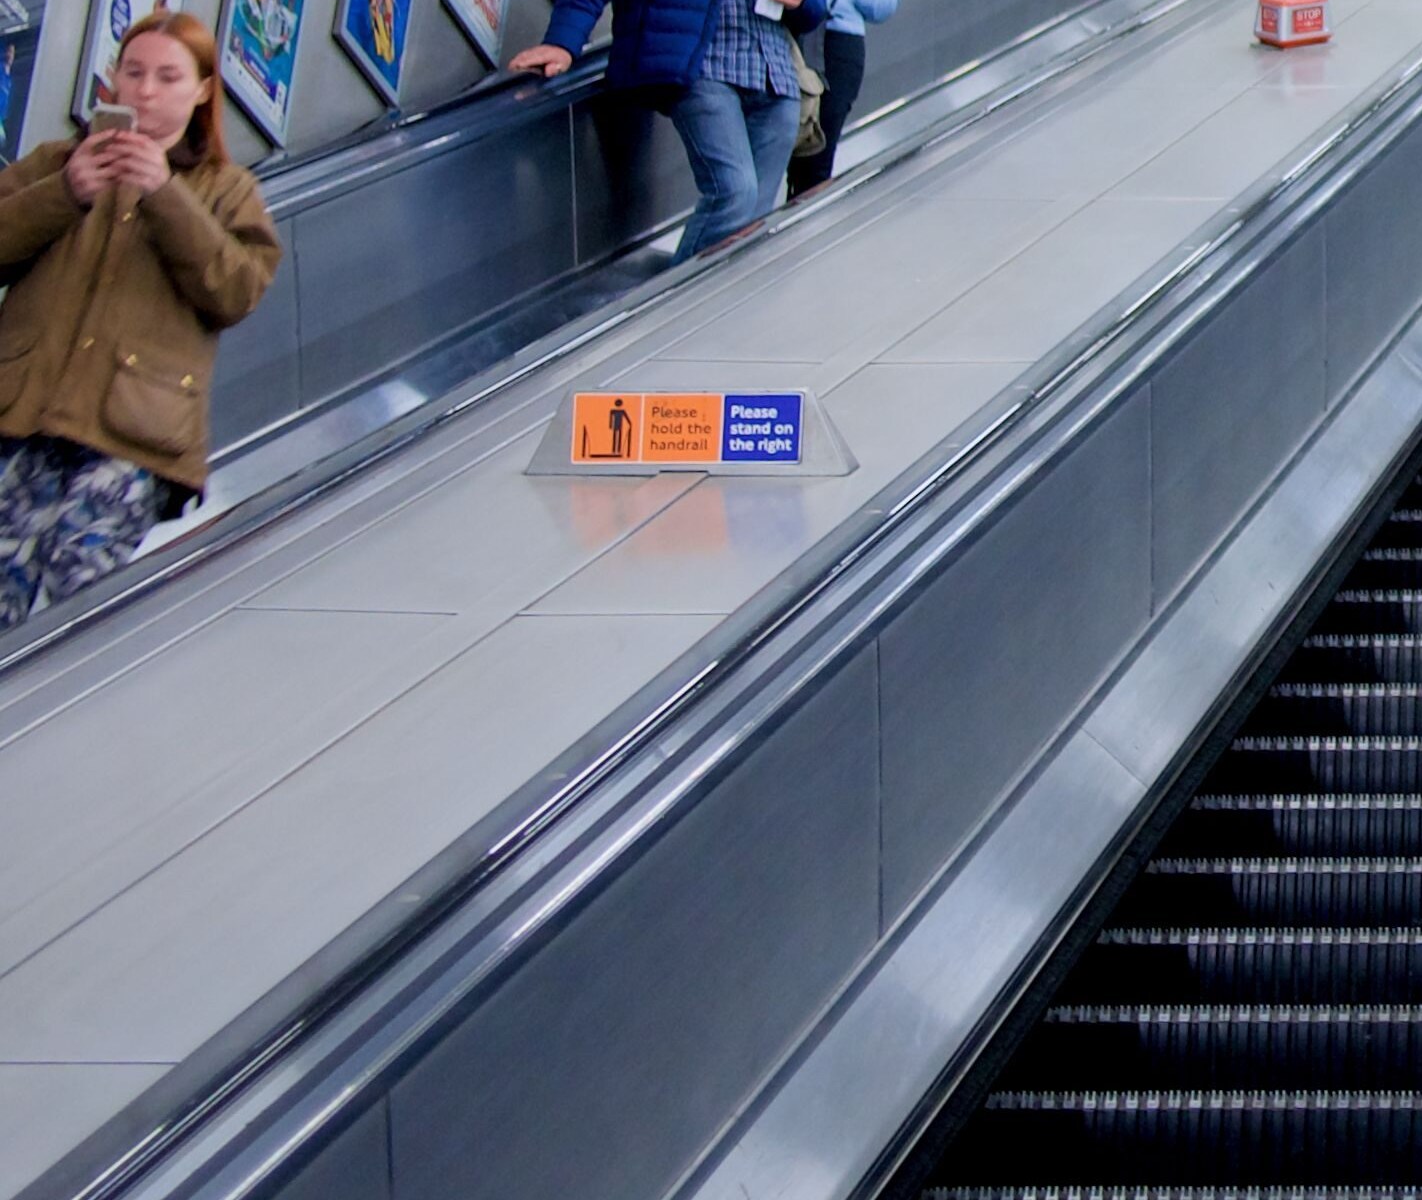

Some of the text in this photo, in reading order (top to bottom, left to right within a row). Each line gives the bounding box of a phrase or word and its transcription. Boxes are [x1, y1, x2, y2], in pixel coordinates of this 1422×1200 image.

[1296, 8, 1321, 21] STOP
[651, 406, 697, 418] Please
[730, 405, 778, 419] Please
[650, 423, 711, 435] hold the
[729, 422, 794, 435] stand on
[650, 439, 708, 451] handrail
[729, 438, 792, 454] the right
